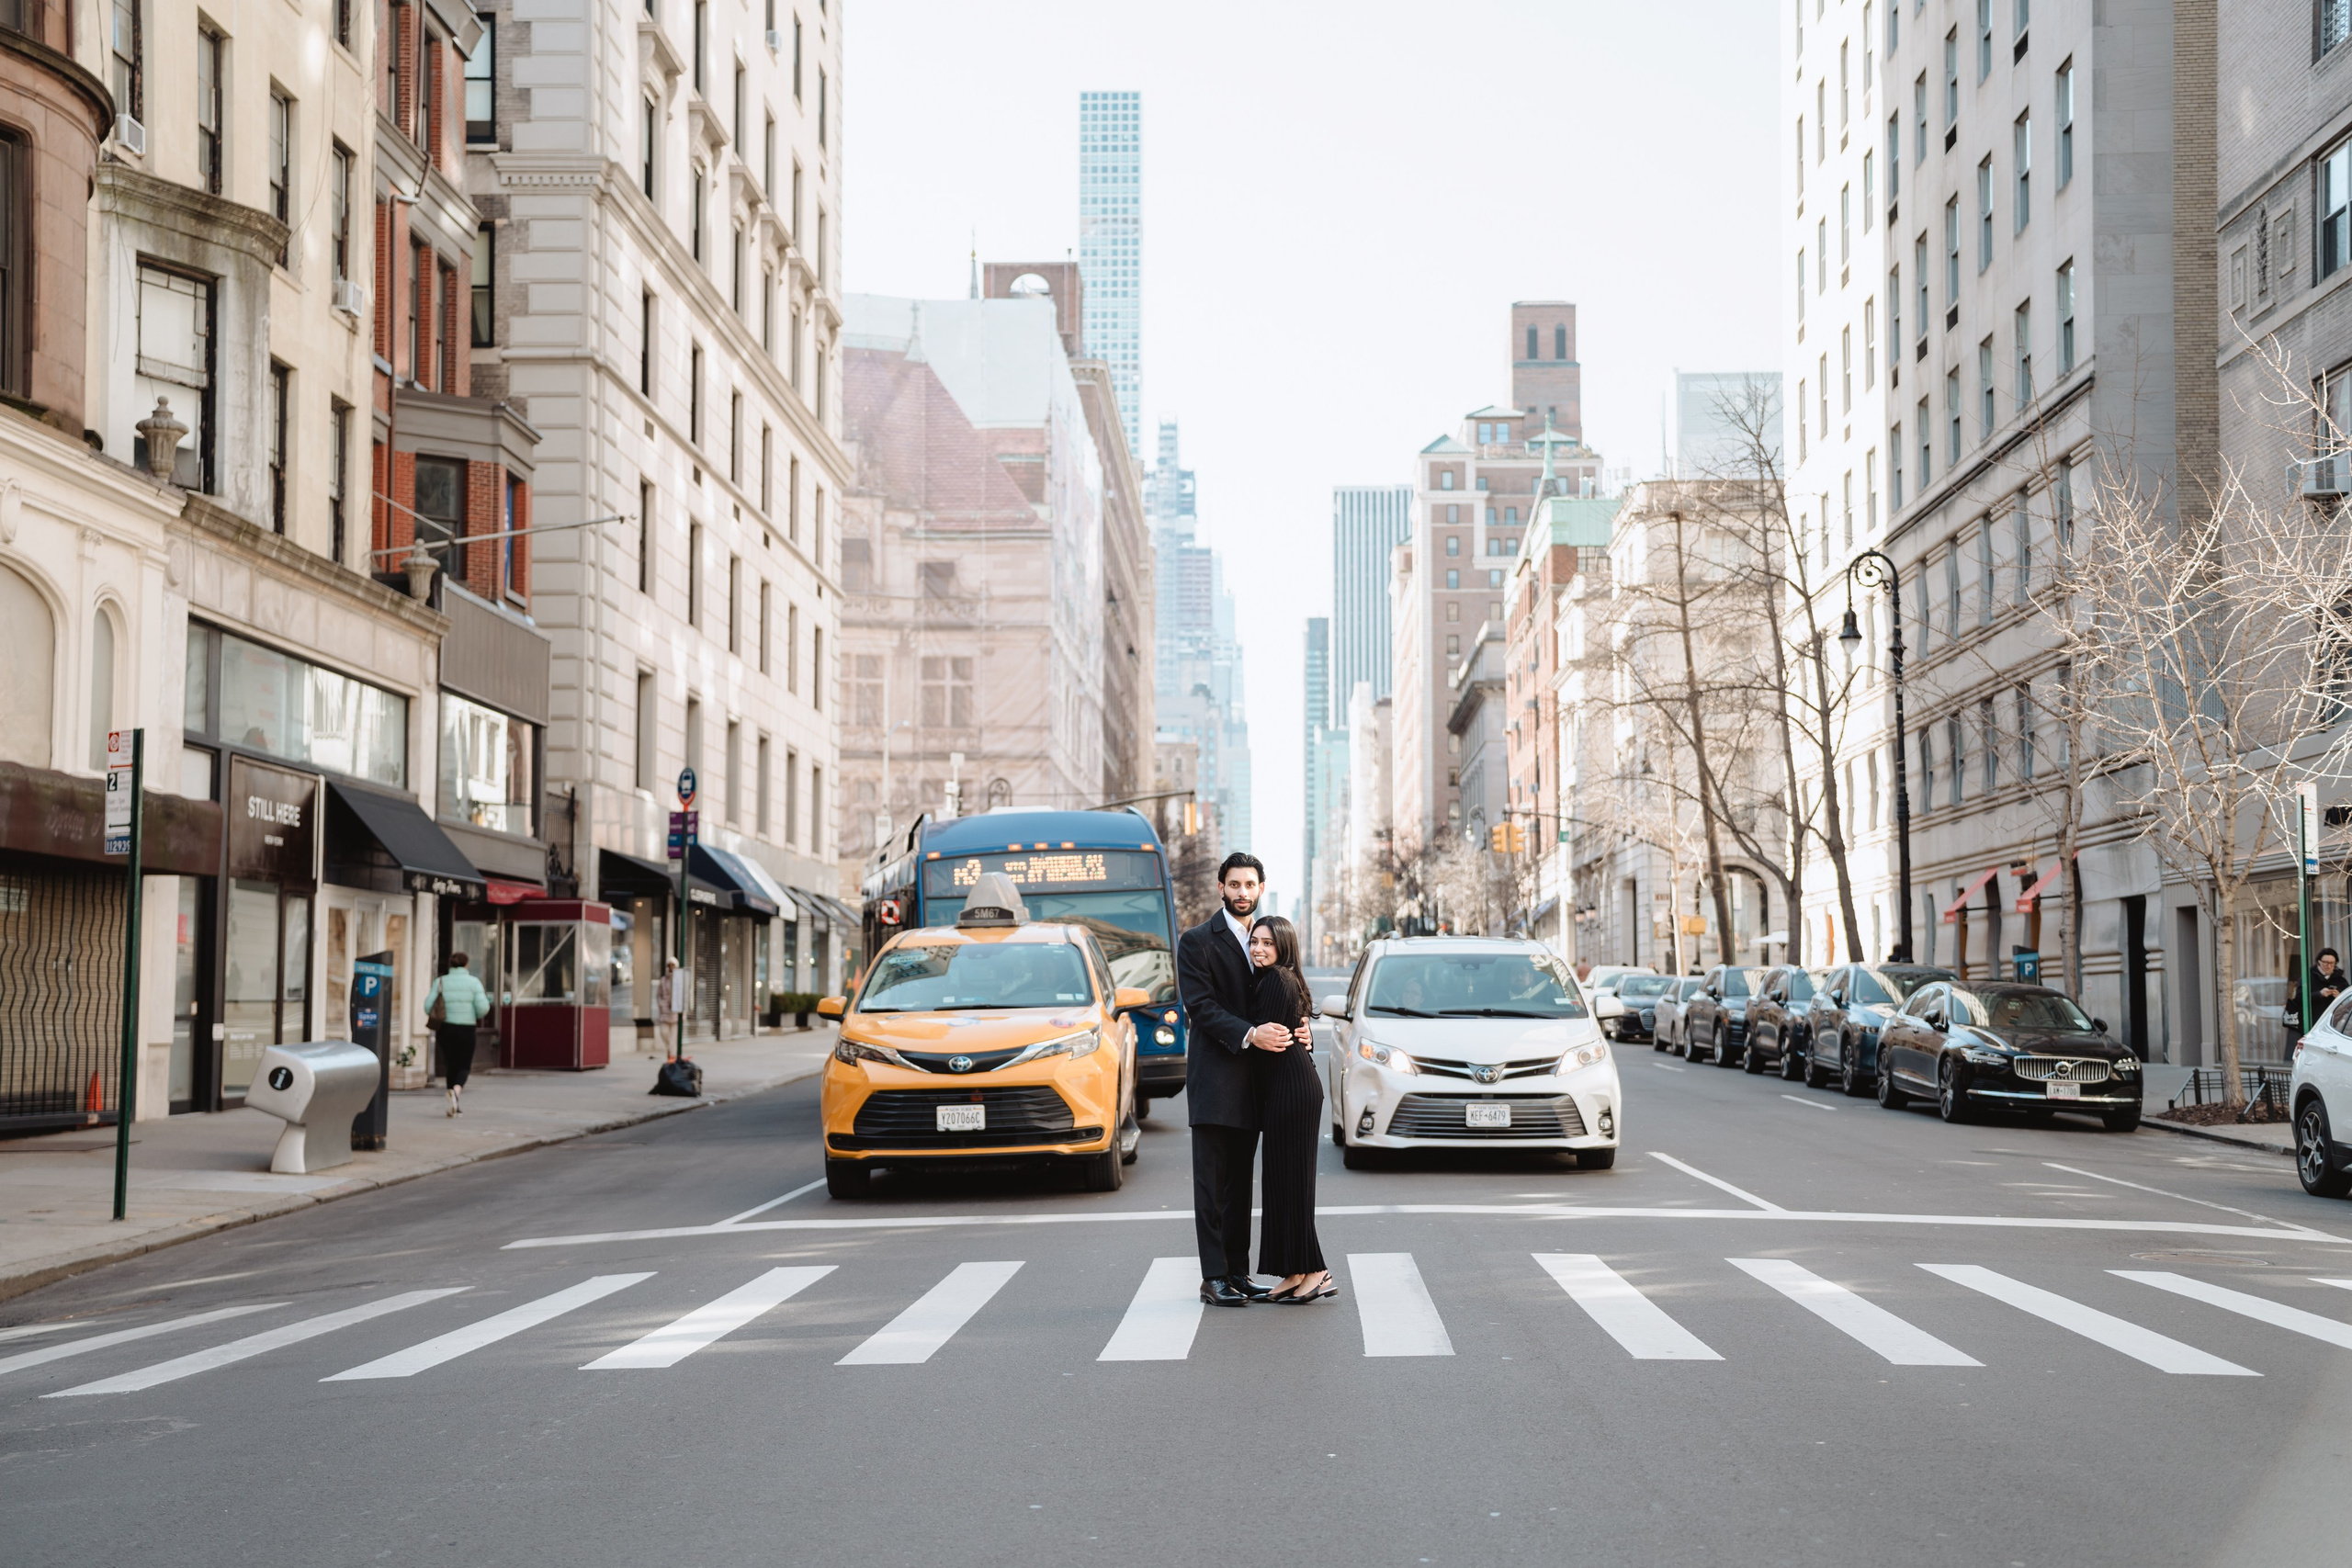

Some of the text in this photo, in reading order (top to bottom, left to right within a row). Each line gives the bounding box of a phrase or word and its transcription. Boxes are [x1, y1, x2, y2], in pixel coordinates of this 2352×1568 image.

[109, 773, 116, 791] 2
[248, 795, 301, 828] STILL HERE
[974, 908, 1000, 919] 5M67
[2024, 962, 2033, 976] P
[365, 976, 378, 995] P
[942, 1111, 980, 1124] Y207066C
